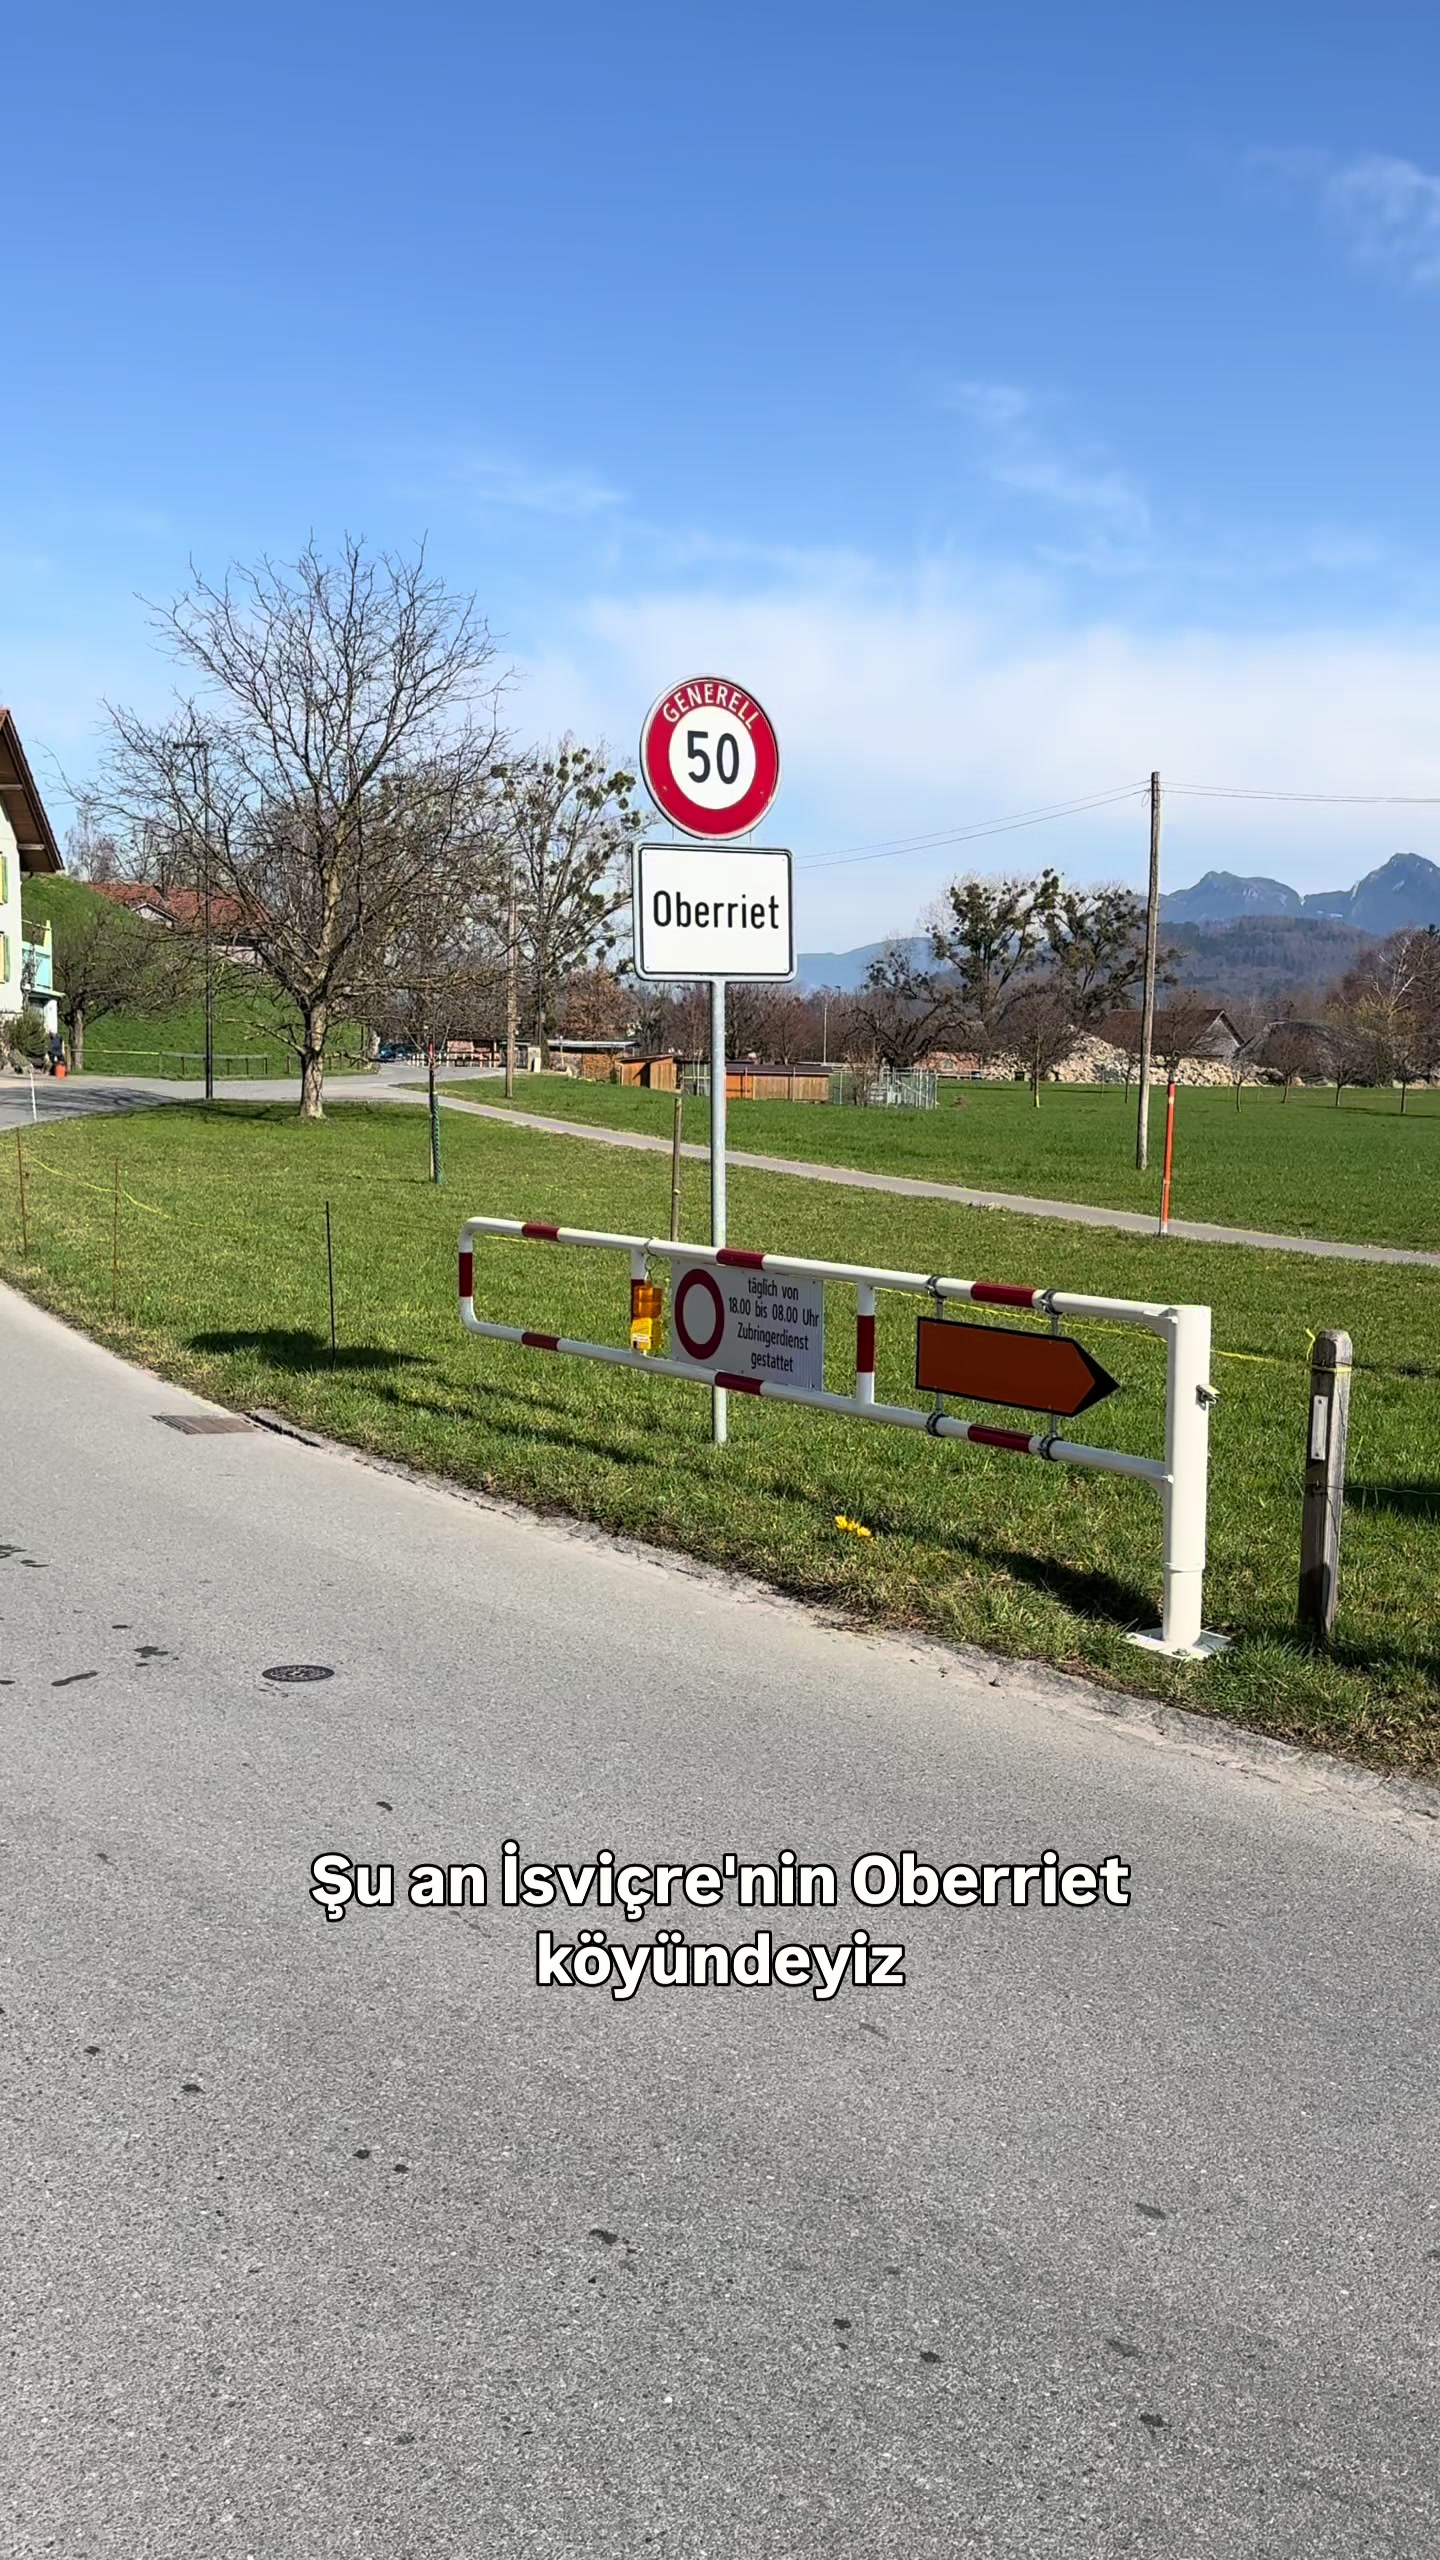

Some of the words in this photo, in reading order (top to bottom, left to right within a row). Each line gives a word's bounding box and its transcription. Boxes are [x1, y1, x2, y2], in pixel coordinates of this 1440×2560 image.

[663, 683, 759, 730] GENERELL
[686, 730, 740, 785] 50
[653, 889, 780, 929] Oberriet
[748, 1277, 778, 1299] täglich
[781, 1286, 799, 1300] von
[728, 1296, 751, 1316] 18.00
[755, 1300, 768, 1319] bis
[772, 1304, 798, 1323] 08.00
[802, 1308, 819, 1327] Uhr
[737, 1322, 809, 1351] Zubringerdienst
[750, 1352, 793, 1373] gestattet
